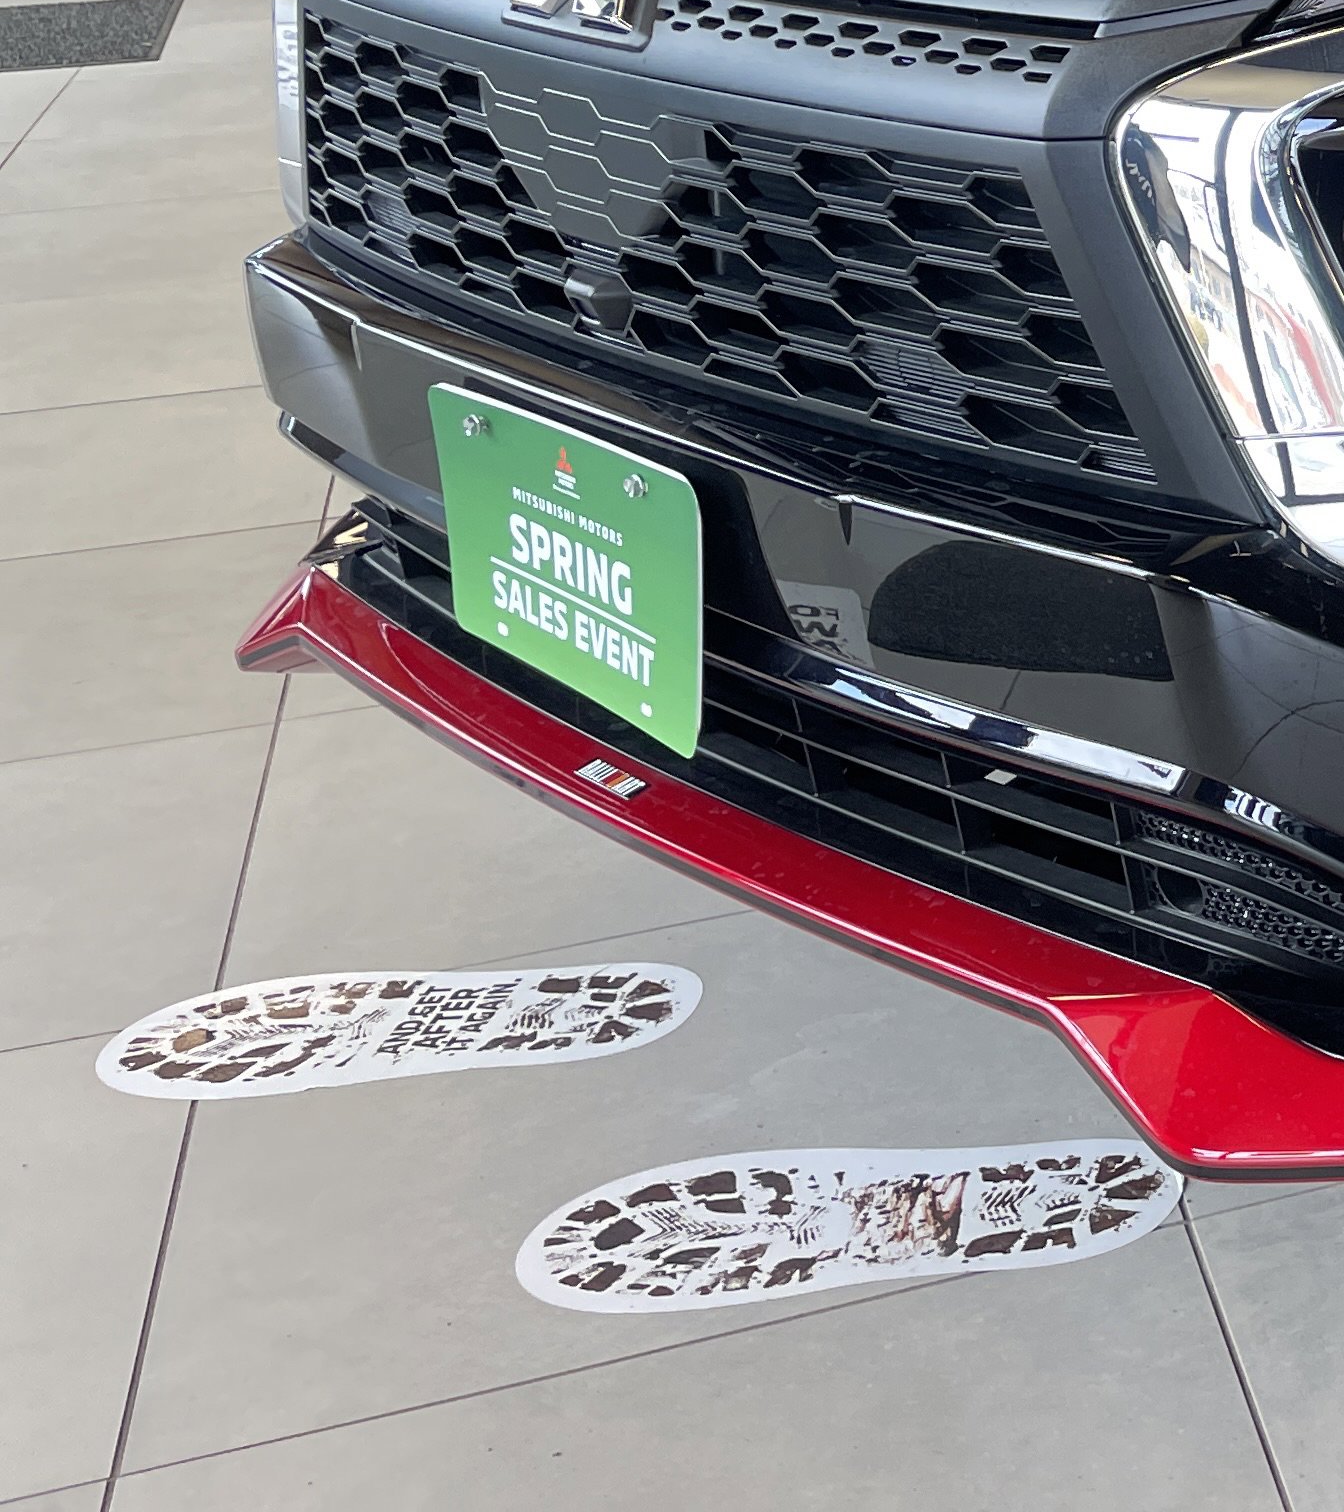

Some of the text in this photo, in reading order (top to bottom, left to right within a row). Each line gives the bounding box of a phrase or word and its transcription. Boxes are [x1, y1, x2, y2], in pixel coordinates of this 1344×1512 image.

[512, 486, 625, 547] MITSUBISHI MOTORS
[509, 513, 633, 616] SPRING
[492, 571, 655, 687] SALES EVENT
[377, 1020, 425, 1054] AND
[412, 987, 489, 1048] AFTER
